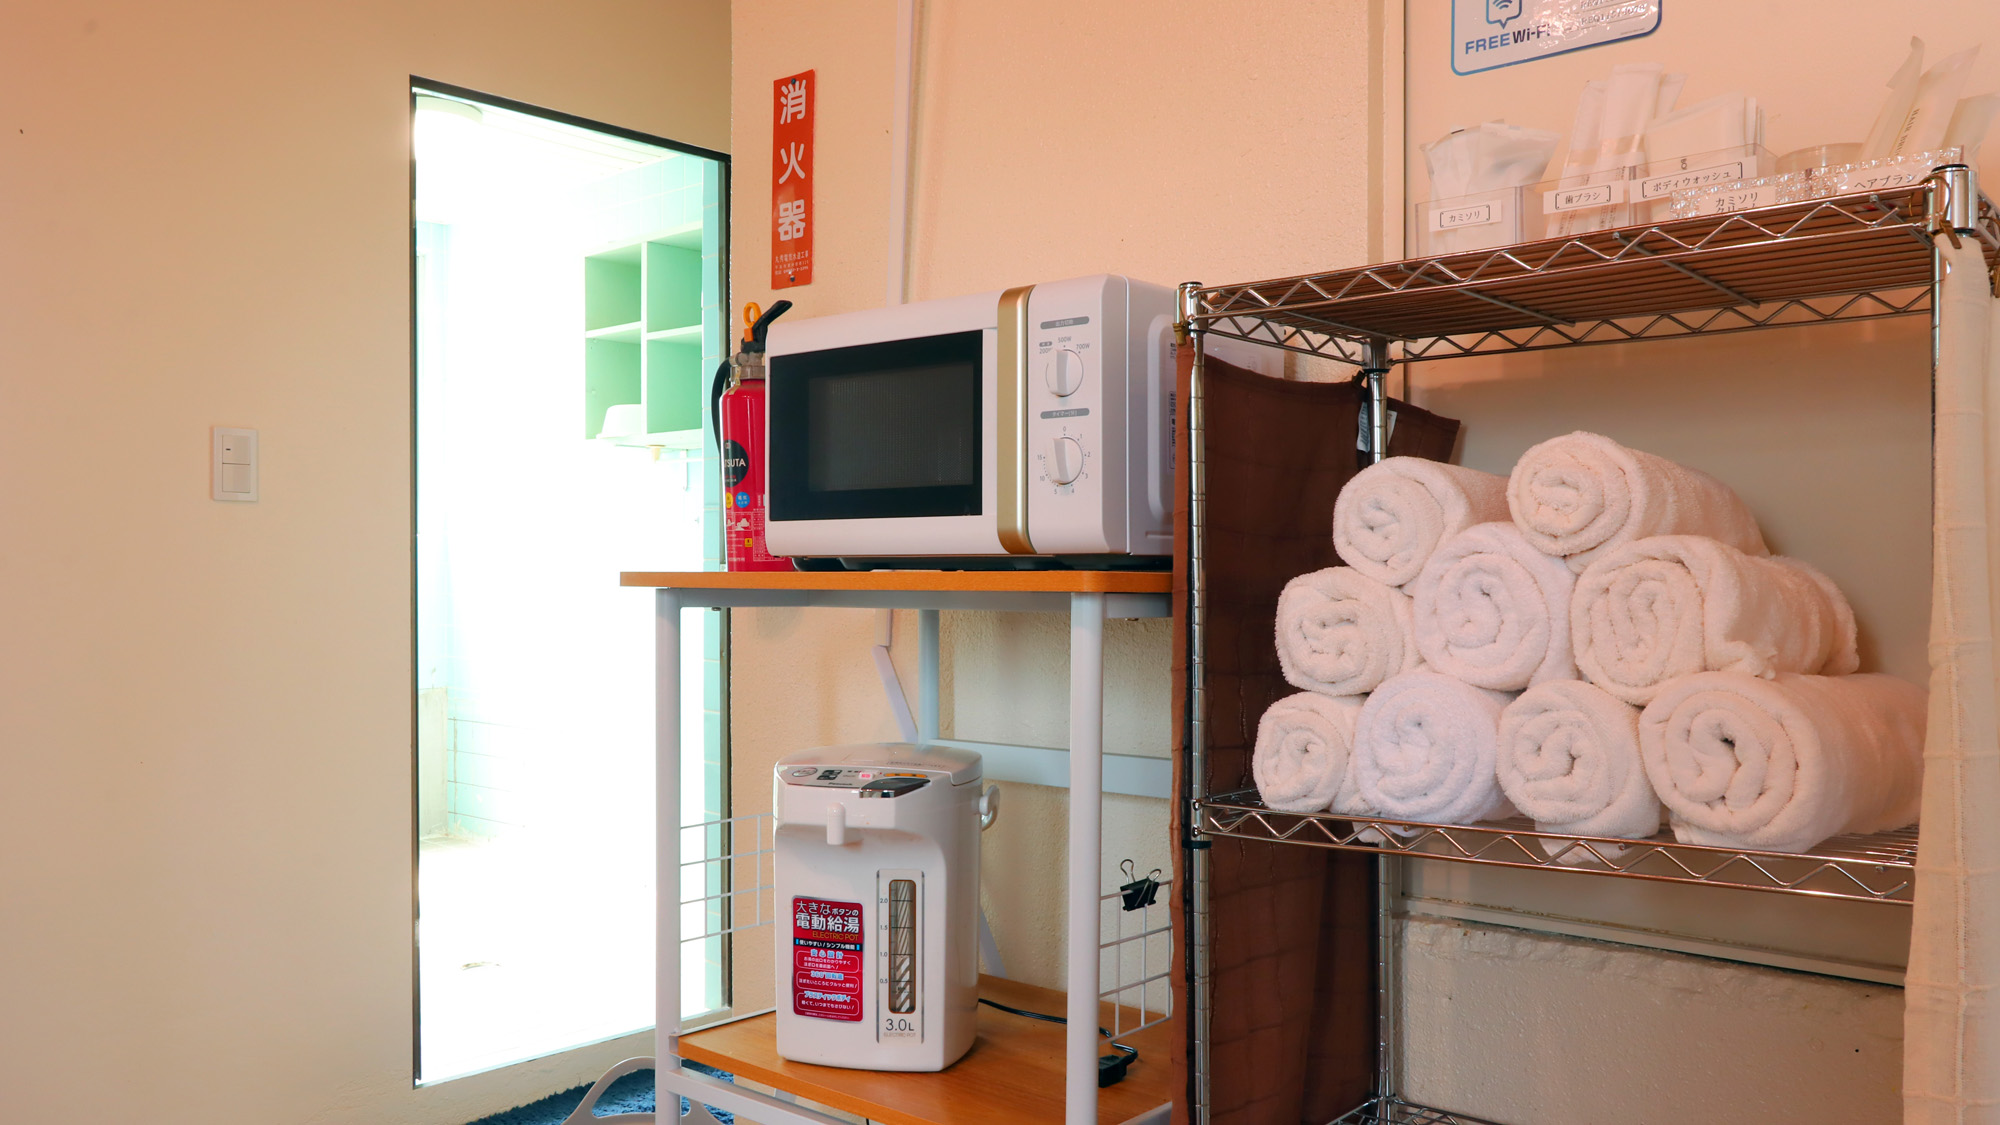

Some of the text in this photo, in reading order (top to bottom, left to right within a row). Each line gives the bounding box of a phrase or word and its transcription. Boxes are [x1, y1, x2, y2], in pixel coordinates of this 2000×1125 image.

[1465, 32, 1511, 54] FREE
[778, 79, 807, 242] 消火器
[1653, 171, 1732, 192] ボディウォッシュ
[1854, 174, 1917, 189] ヘアブラシ
[1565, 192, 1601, 205] 歯ブラシ
[1715, 192, 1758, 208] カミソリ
[1717, 203, 1756, 213] クリー
[1448, 210, 1481, 223] カミソリ
[796, 900, 859, 916] 大きなボタンの
[795, 912, 860, 934] 電動給湯
[812, 930, 859, 941] ELECTRIC POT
[885, 1018, 915, 1031] 3.0L
